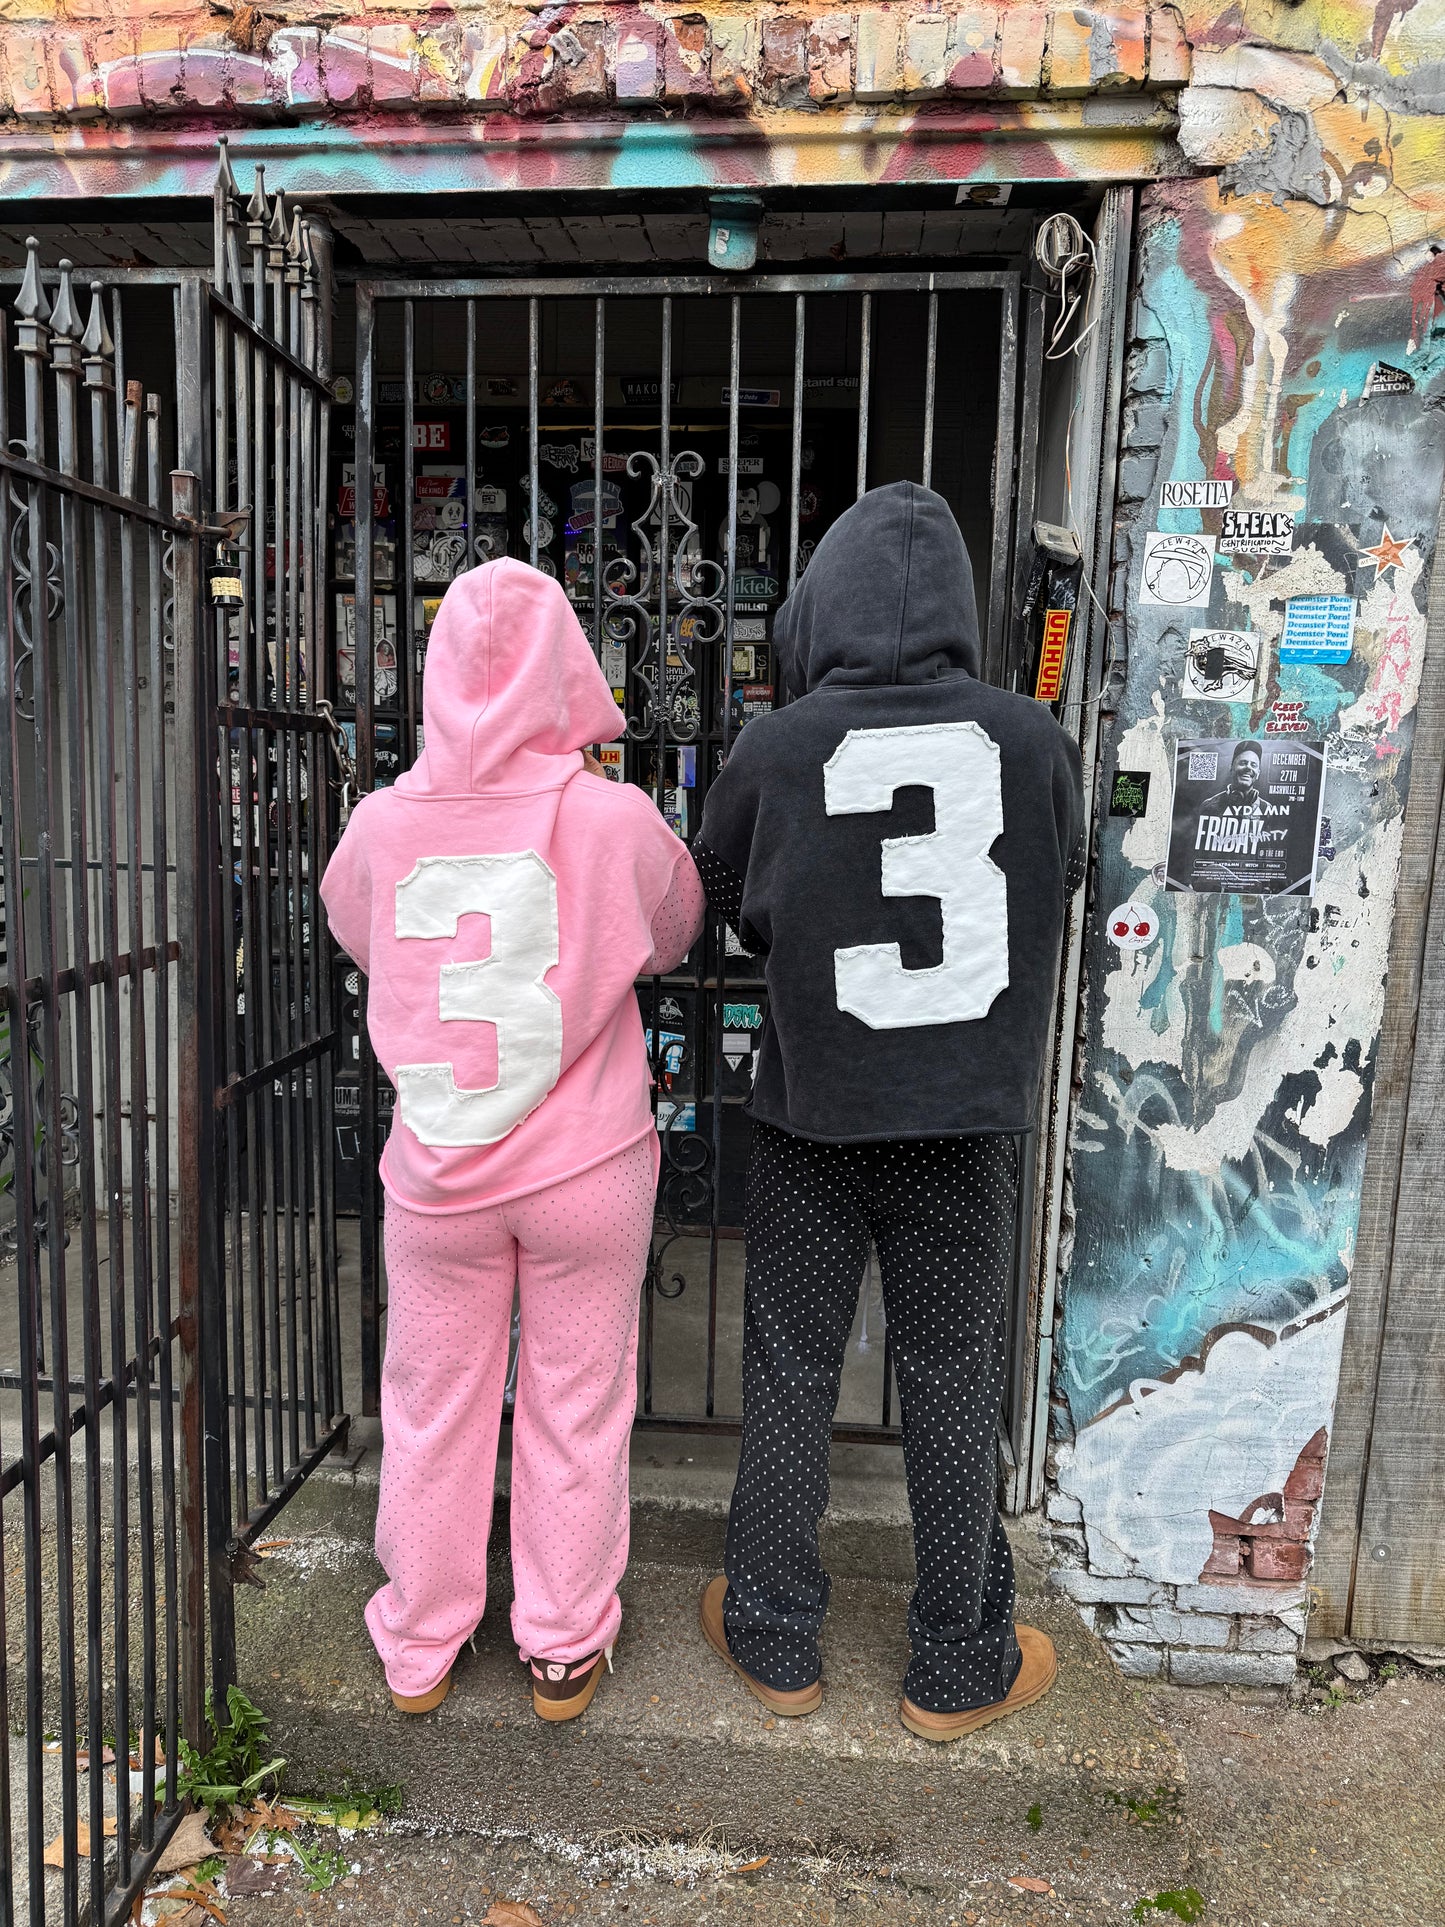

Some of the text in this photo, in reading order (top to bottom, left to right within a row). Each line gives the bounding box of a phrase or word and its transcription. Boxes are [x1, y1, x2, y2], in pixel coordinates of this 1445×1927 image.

[836, 377, 859, 388] still
[1373, 374, 1403, 383] CKER
[1371, 383, 1410, 392] ELTON
[1161, 482, 1230, 506] ROSETTA
[1221, 511, 1292, 539] STEAK
[1221, 539, 1285, 548] GENTRIFICATION
[1225, 545, 1289, 554] SUCKS
[735, 576, 775, 595] iktek
[1291, 595, 1353, 603] Deemster Porn!
[1328, 604, 1352, 612] Porn!
[1287, 612, 1327, 620] Deemster
[1287, 621, 1326, 629] Deemster
[1326, 630, 1349, 638] Porn!
[1211, 634, 1243, 646] EW42
[1285, 638, 1348, 647] Deemster Porn!
[1040, 614, 1066, 698] UHHUH
[655, 667, 688, 675] NSHVILL
[1273, 702, 1303, 712] KEEP
[1277, 713, 1297, 722] THE
[1266, 722, 1308, 732] ELEVEN
[1272, 753, 1307, 766] DECEMBER
[1280, 769, 1298, 782] 27TH
[1269, 785, 1306, 796] NASHVILLE, TN
[1222, 805, 1290, 816] AYDAMN
[1194, 814, 1265, 855] FRIDAY
[1248, 828, 1289, 844] PARTY
[822, 720, 1010, 1030] 3
[395, 849, 560, 1147] 3
[722, 1003, 763, 1030] DSML
